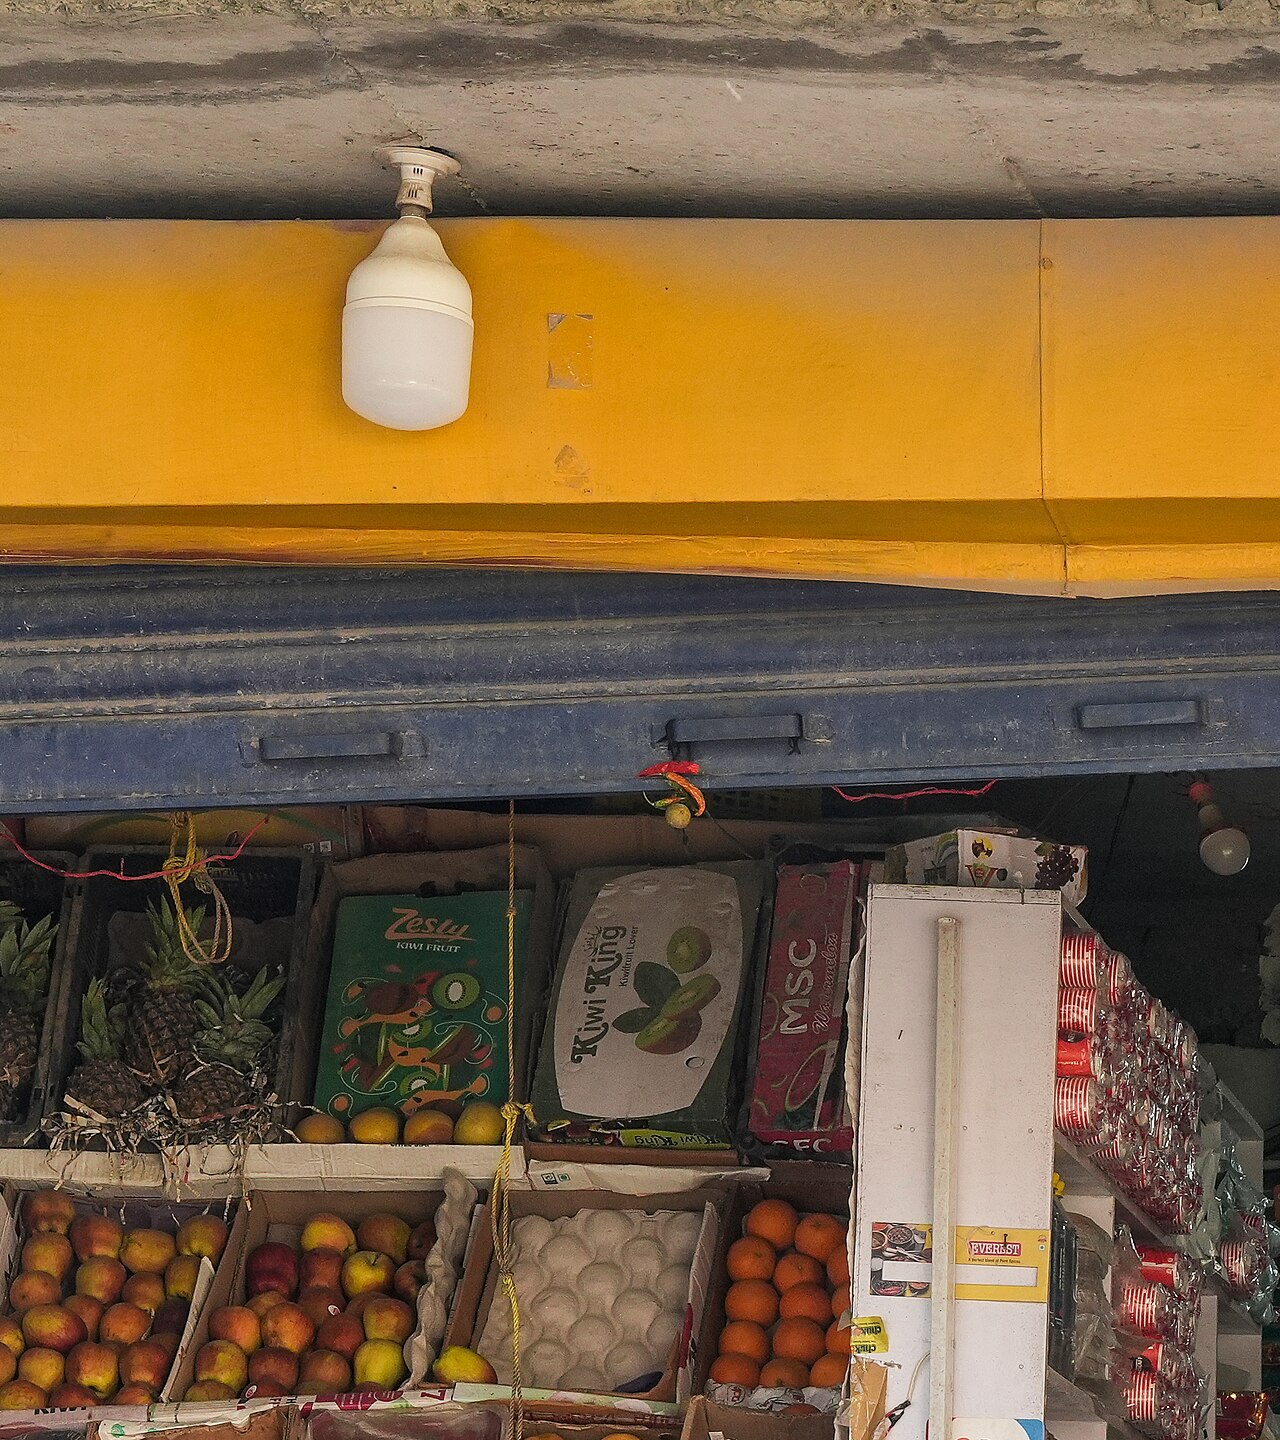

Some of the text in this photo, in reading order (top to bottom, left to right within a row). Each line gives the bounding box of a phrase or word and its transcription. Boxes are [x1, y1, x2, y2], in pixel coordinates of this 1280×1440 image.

[384, 907, 477, 941] Zesty
[396, 941, 461, 953] KIWI FRUIT
[619, 925, 639, 987] Kiwifruit Lover
[571, 925, 626, 1064] Kiwi King
[780, 937, 818, 1036] MSC
[970, 1241, 1021, 1256] EVEREST
